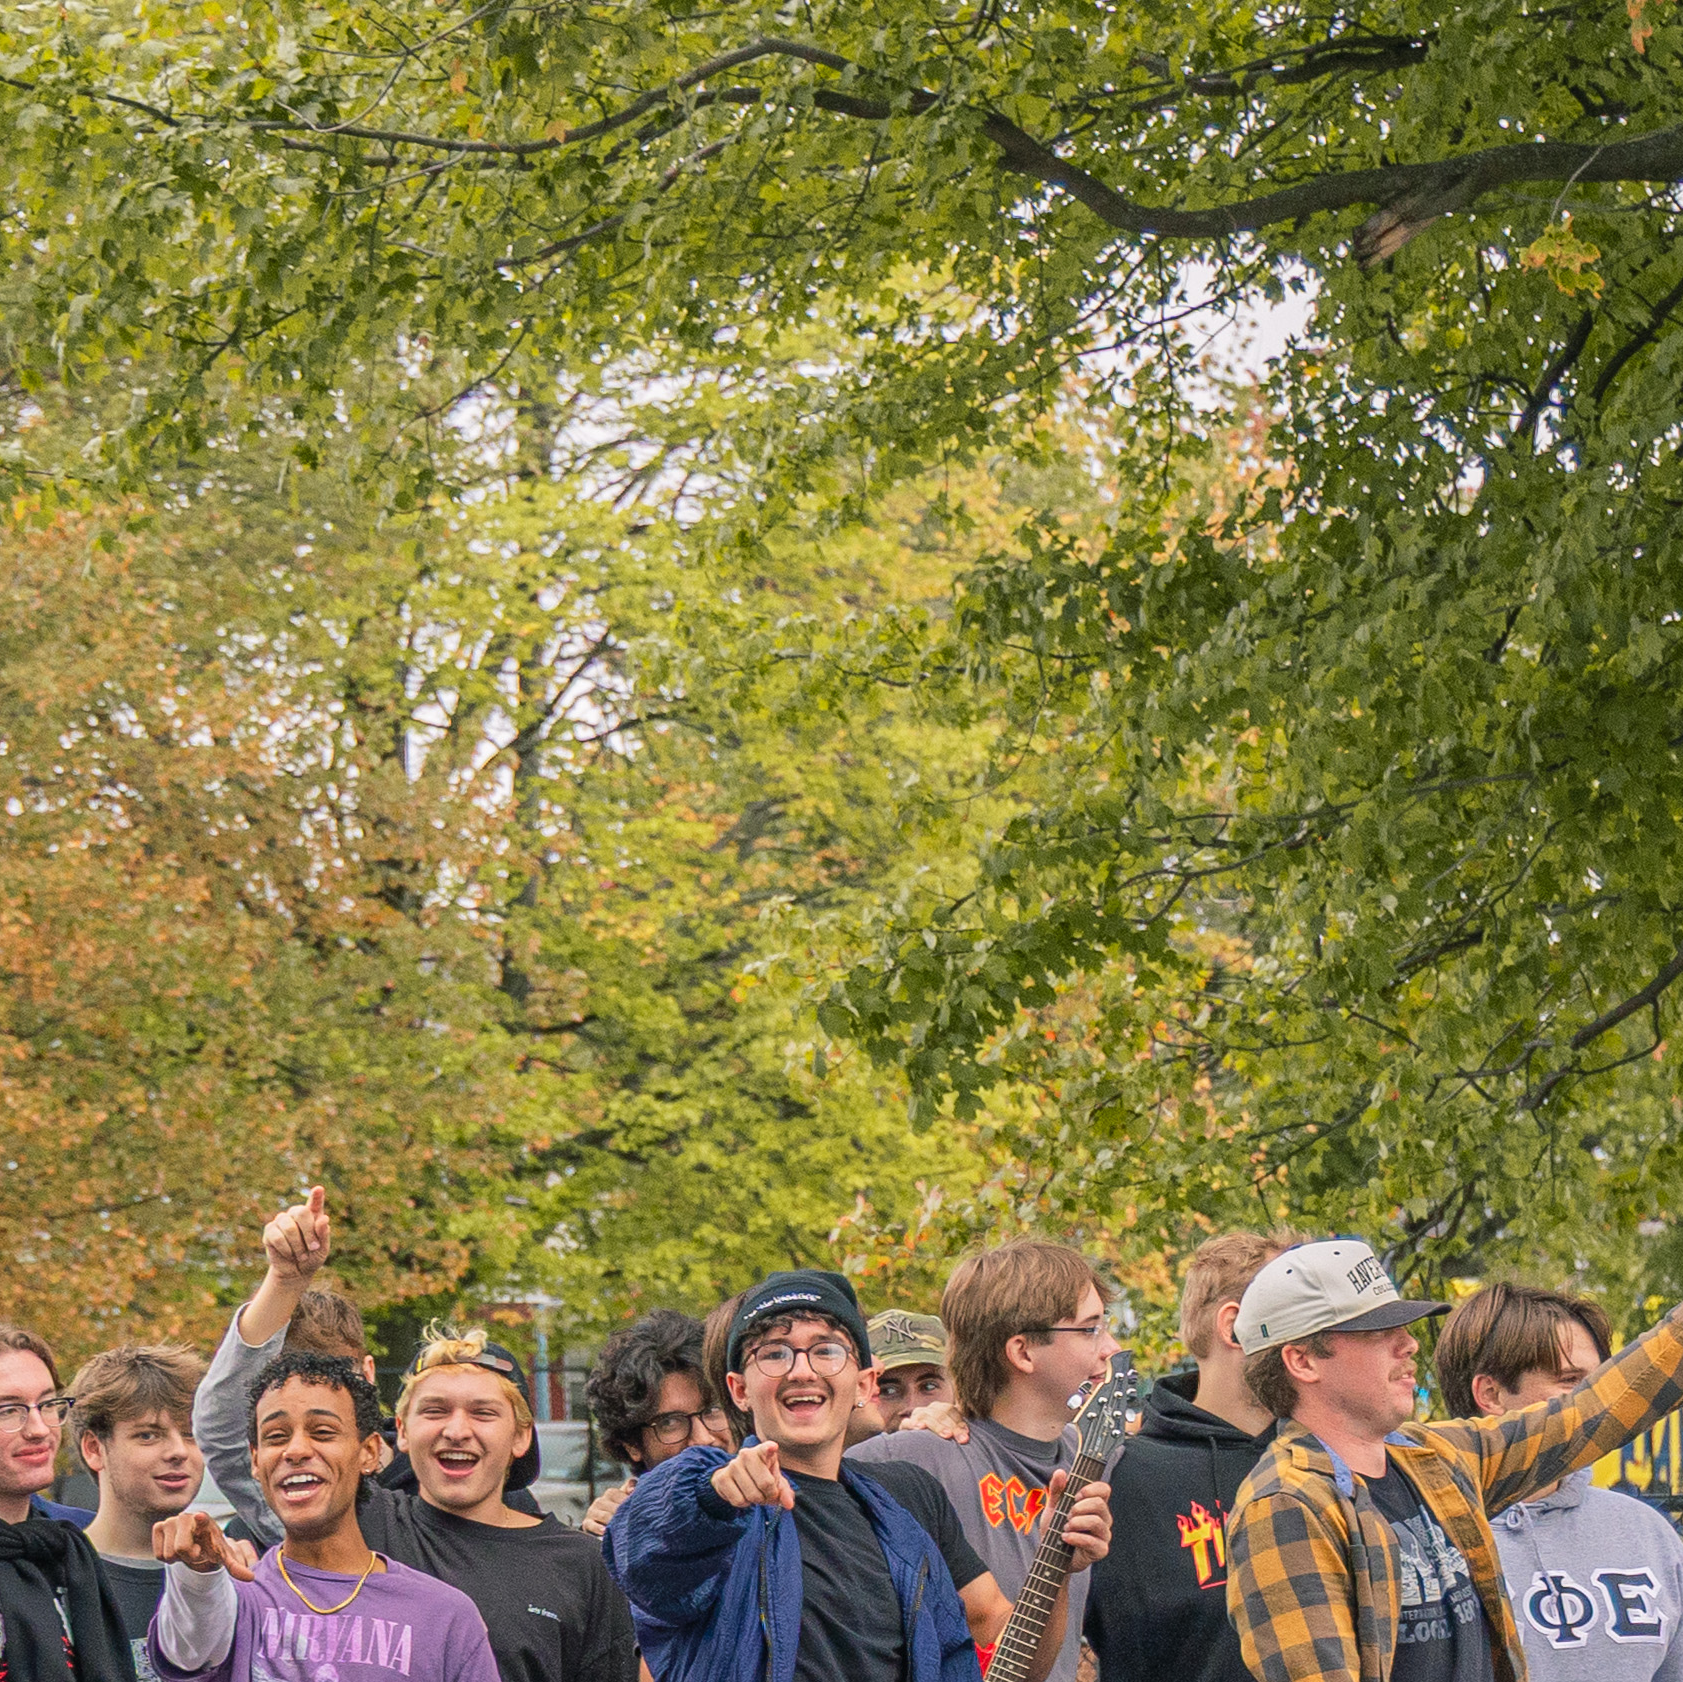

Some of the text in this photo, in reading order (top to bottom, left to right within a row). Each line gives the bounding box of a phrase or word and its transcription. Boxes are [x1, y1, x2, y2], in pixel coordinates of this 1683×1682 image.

[883, 1315, 915, 1343] NY
[256, 1606, 413, 1677] NIRVANA
[1508, 1566, 1669, 1650] ΦΕ
